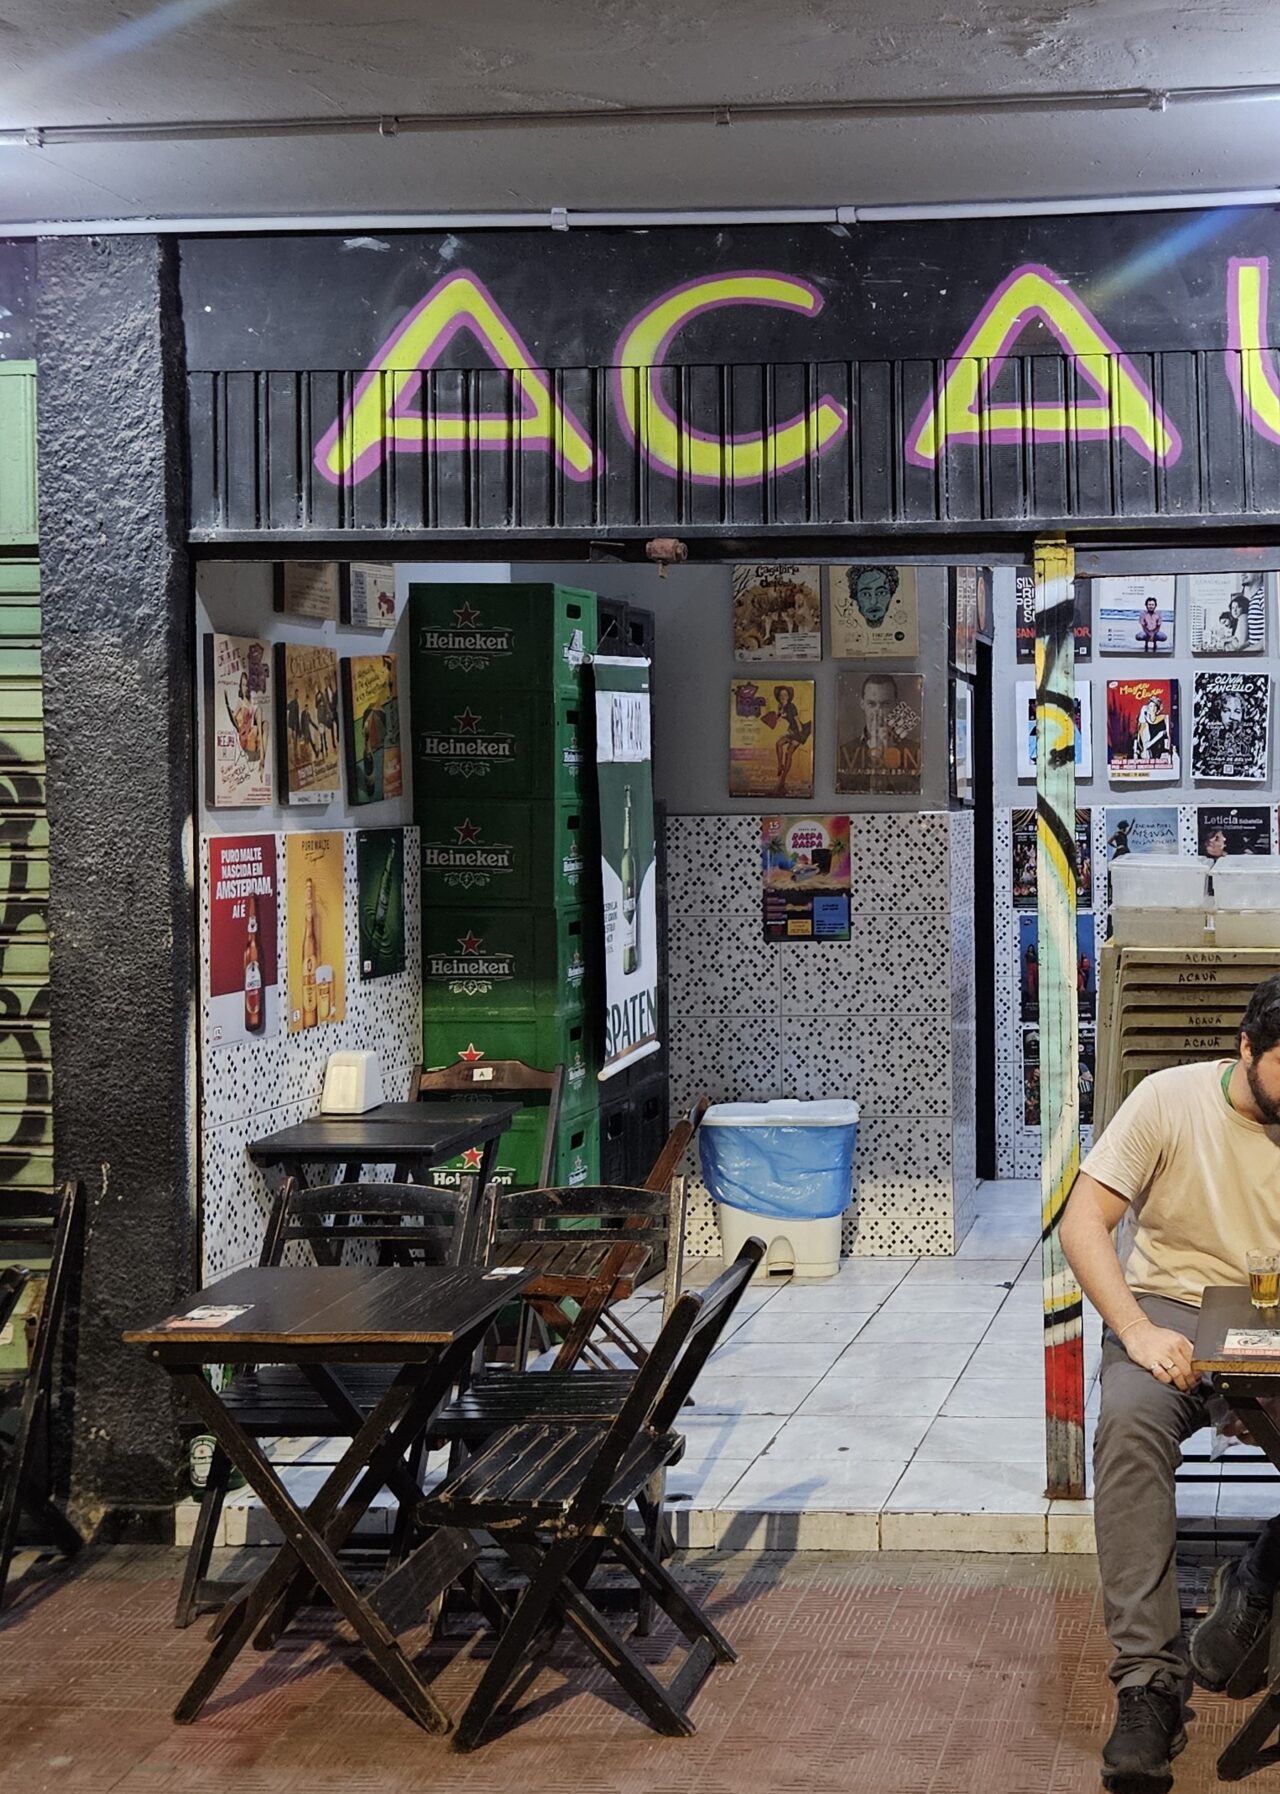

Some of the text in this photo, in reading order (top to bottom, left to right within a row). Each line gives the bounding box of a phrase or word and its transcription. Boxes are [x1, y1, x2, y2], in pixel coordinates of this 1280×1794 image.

[426, 633, 508, 649] Heineken
[426, 738, 510, 755] Heineken
[792, 832, 823, 840] RASPA
[792, 840, 823, 848] RASPA
[221, 847, 262, 864] PURO MALTE
[425, 849, 509, 866] Heineken
[221, 862, 263, 879] NASCIDA EM
[431, 960, 510, 975] Heineken
[1179, 970, 1217, 982] ACAUÃ
[606, 986, 658, 1057] SPATEN
